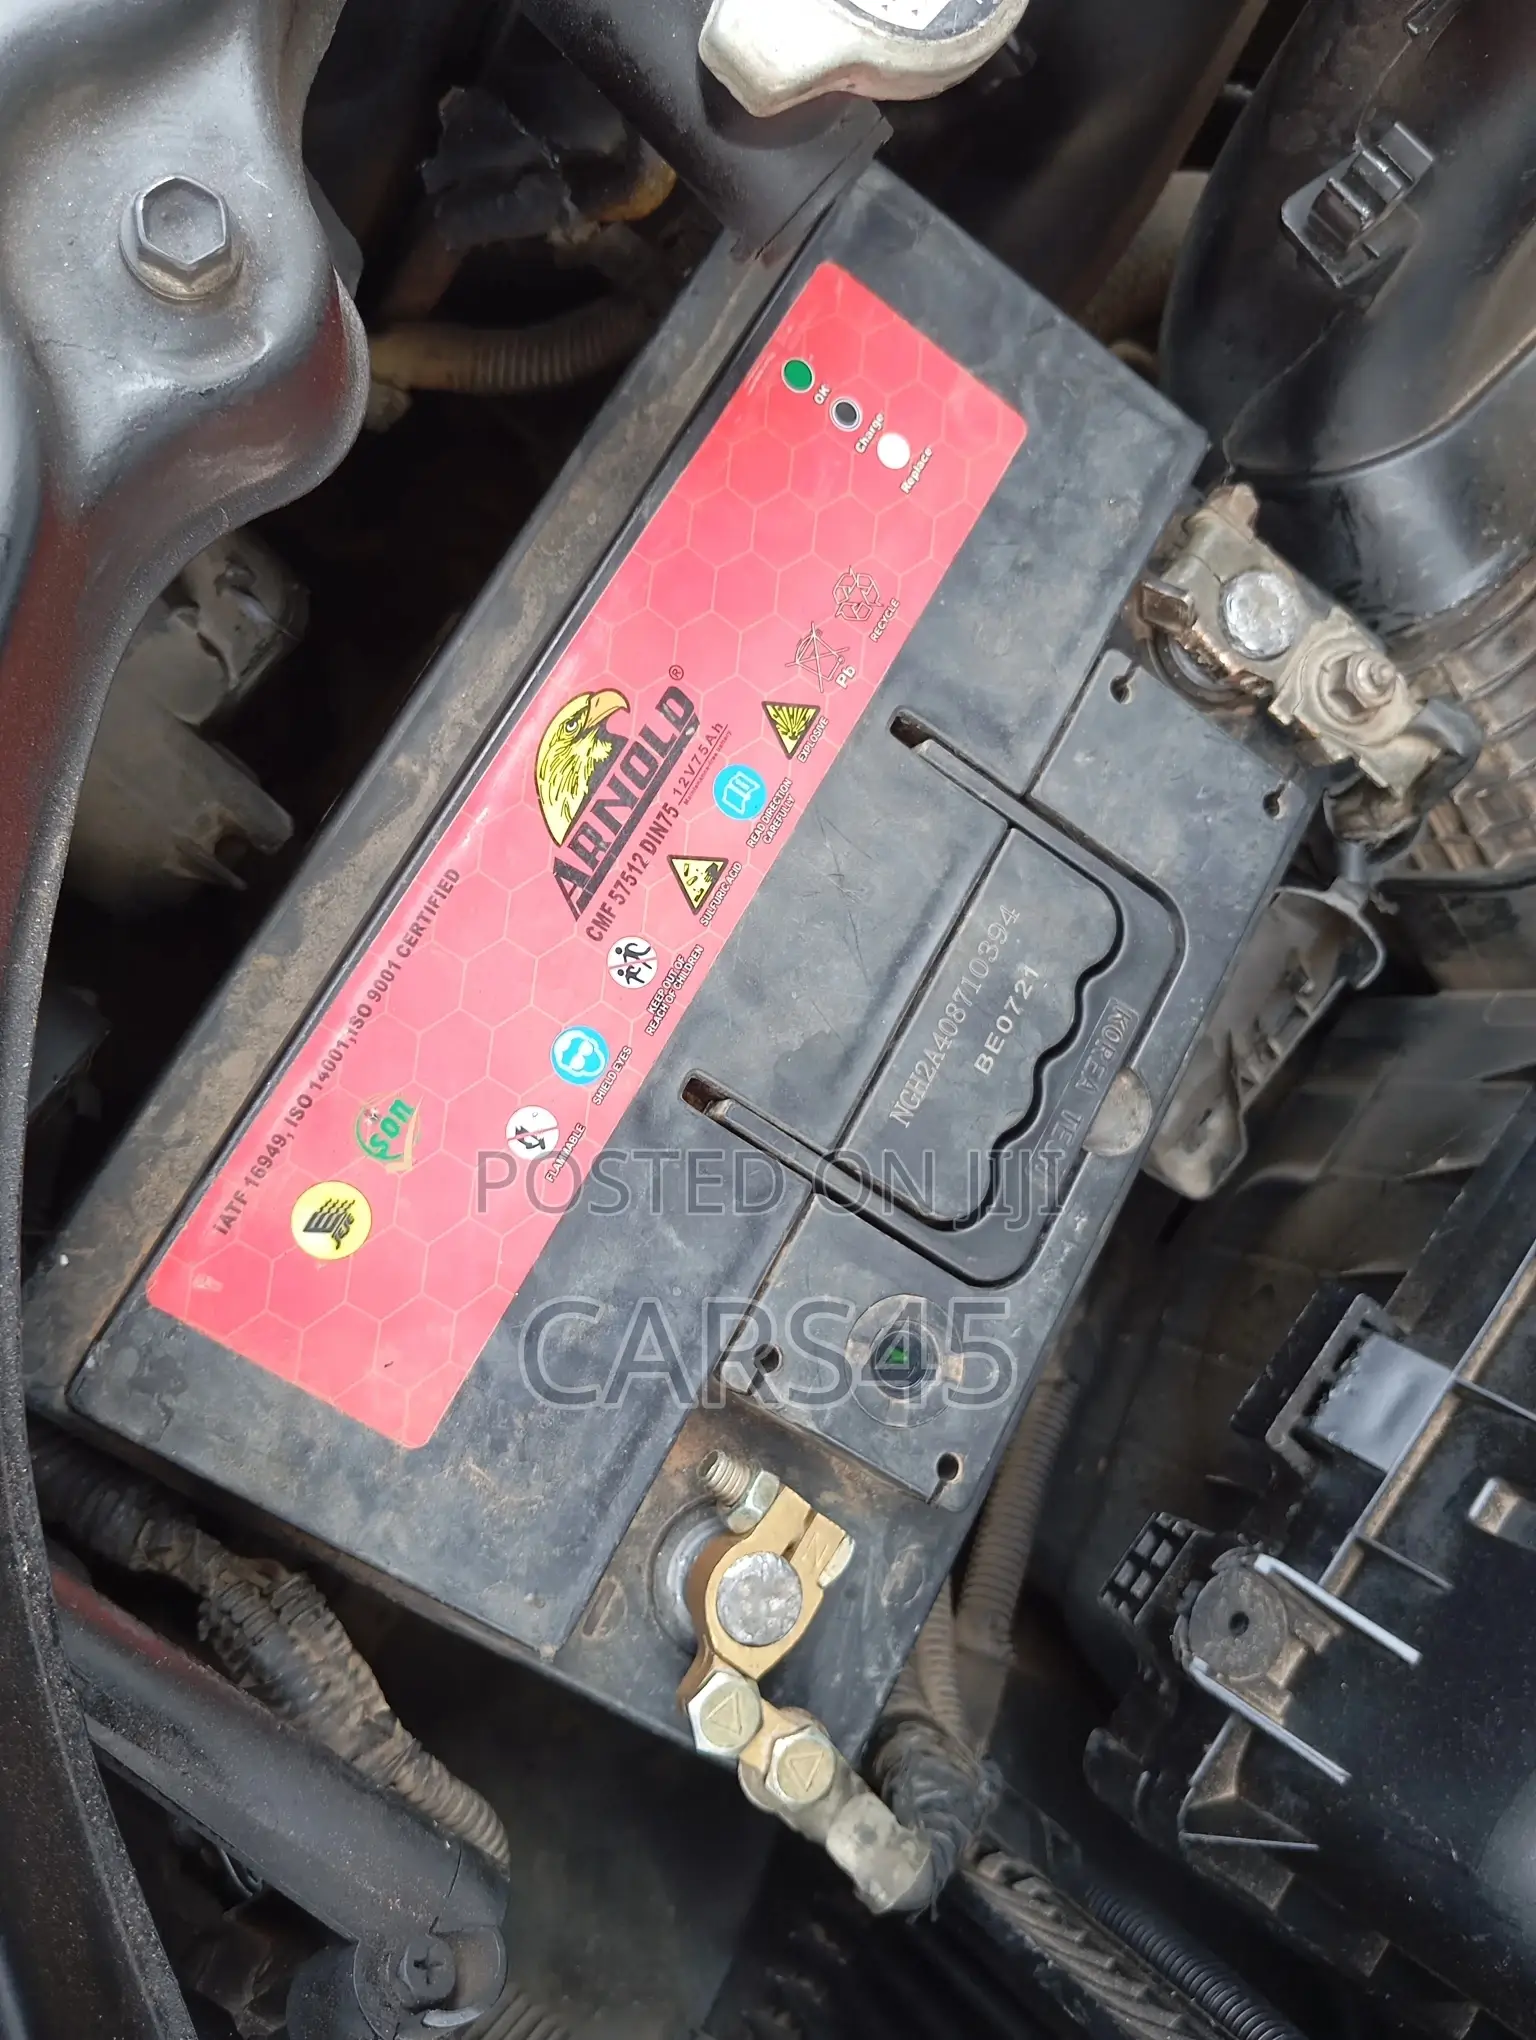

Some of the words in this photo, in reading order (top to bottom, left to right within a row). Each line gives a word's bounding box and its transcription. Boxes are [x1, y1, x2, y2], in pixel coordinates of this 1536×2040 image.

[814, 383, 831, 405] OK
[856, 413, 884, 453] Charge
[900, 446, 933, 494] Replace
[869, 598, 900, 642] RECYCLE
[835, 666, 856, 689] Pb
[797, 716, 829, 763] EXPLOSIVE
[553, 686, 695, 921] ARNOLD
[747, 822, 766, 848] READ
[761, 777, 793, 824] DIRECTION
[762, 794, 796, 844] CAREFULLY
[584, 901, 618, 941] CMF
[607, 852, 650, 906] 57512
[639, 802, 681, 855] DIN75
[699, 883, 730, 927] SULFURIC
[725, 861, 743, 884] ACID
[645, 1003, 669, 1036] REACH
[664, 989, 677, 1004] OF
[672, 945, 704, 991] CHILDREN
[647, 988, 667, 1014] KEEP
[661, 967, 679, 990] OUT
[673, 955, 686, 970] OF
[243, 1132, 293, 1187] 16949,
[283, 1092, 314, 1128] ISO
[366, 959, 402, 1004] 9001
[394, 867, 462, 960] CERTIFIED
[889, 906, 1021, 1128] NGH2A408710394
[974, 964, 1039, 1075] BE0721
[591, 1071, 617, 1105] SHIELD
[612, 1046, 633, 1072] EYES
[1075, 1006, 1132, 1090] KOREA
[545, 1123, 586, 1182] FLAMMABLE
